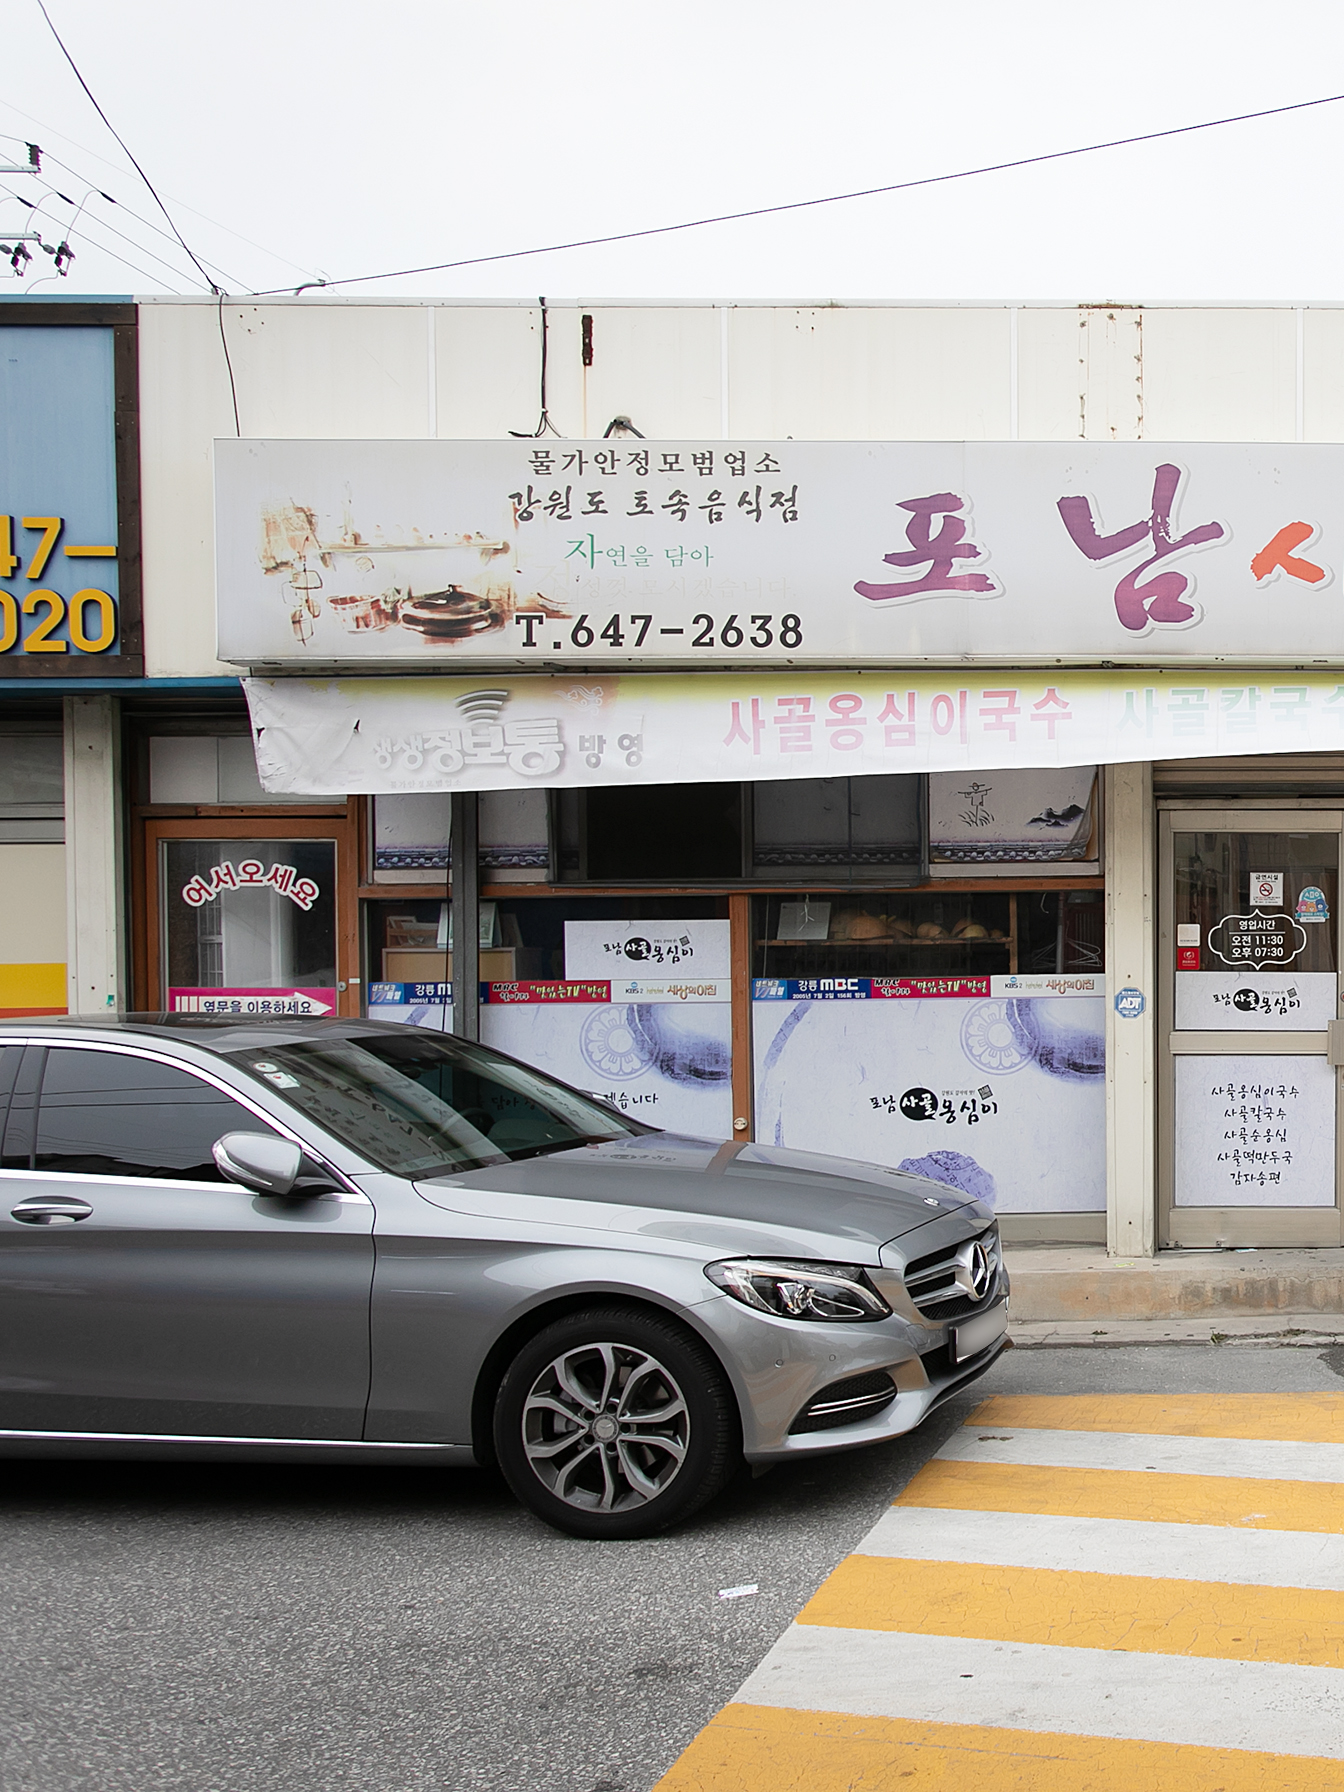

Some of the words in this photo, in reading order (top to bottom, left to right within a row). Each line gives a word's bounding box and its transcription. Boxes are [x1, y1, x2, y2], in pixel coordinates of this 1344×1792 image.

[528, 449, 782, 477] 물가안정모범업소
[508, 484, 609, 522] 강원도
[626, 484, 800, 524] 토속음식점
[564, 532, 654, 569] 자연을
[664, 545, 714, 568] 담아
[514, 612, 804, 650] T.647-2638
[722, 687, 1073, 755] 사골옹심이국수
[578, 733, 643, 769] 방영
[183, 859, 319, 911] 어서오세요
[1239, 919, 1276, 930] 영업시간
[1231, 936, 1251, 946] 오전
[1255, 936, 1284, 946] 11:30
[1231, 948, 1252, 958] 오후
[1254, 948, 1284, 958] 07:30
[415, 984, 436, 996] 강릉
[798, 979, 818, 991] 강릉
[820, 978, 859, 991] MBC
[1119, 997, 1141, 1010] ADT
[1211, 1083, 1300, 1101] 사골옹심이국수
[1224, 1105, 1287, 1123] 사골칼국수
[1223, 1127, 1287, 1145] 사골순옹심
[1217, 1149, 1293, 1167] 사골떡만두국
[1230, 1171, 1281, 1187] 감자송편
